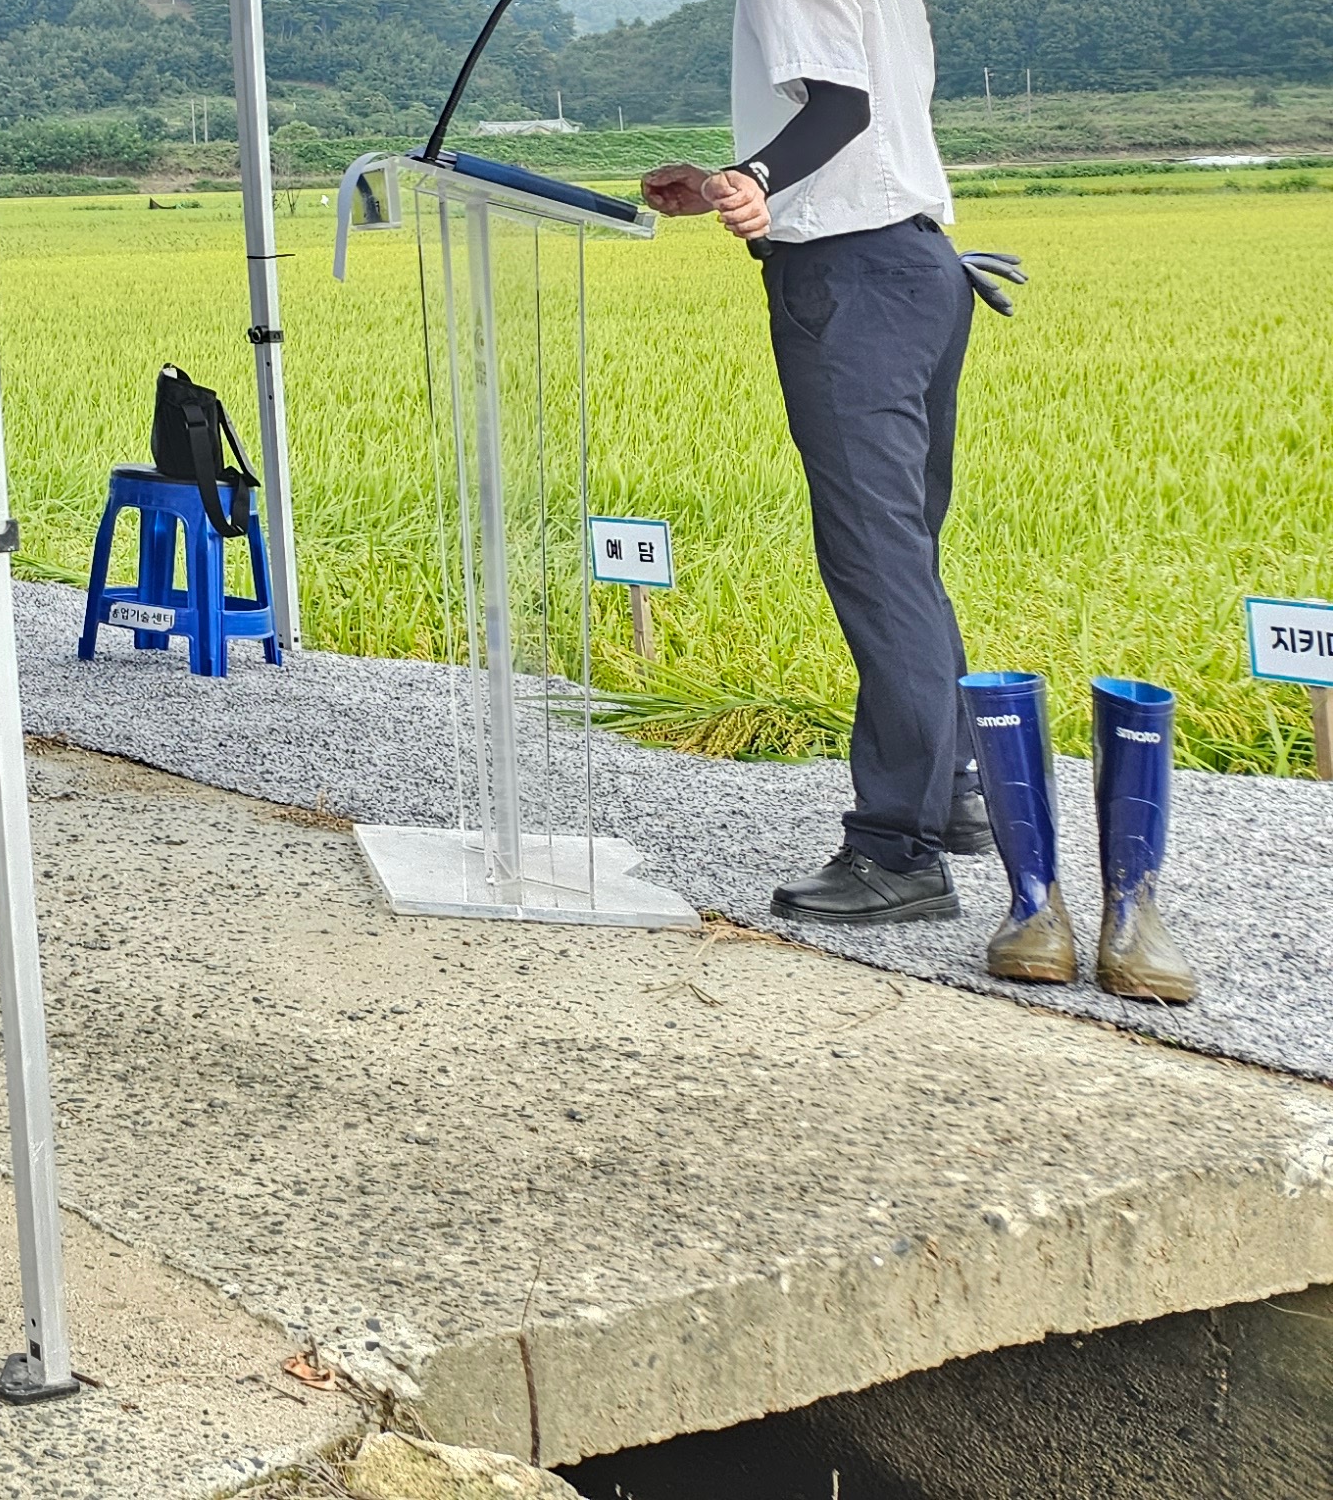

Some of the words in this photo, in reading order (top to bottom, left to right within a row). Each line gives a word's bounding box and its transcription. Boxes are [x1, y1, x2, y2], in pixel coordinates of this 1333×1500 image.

[112, 607, 173, 627] 농업기술센터
[1269, 625, 1333, 657] 지키
[976, 714, 1021, 728] smato
[1115, 726, 1161, 744] smato
